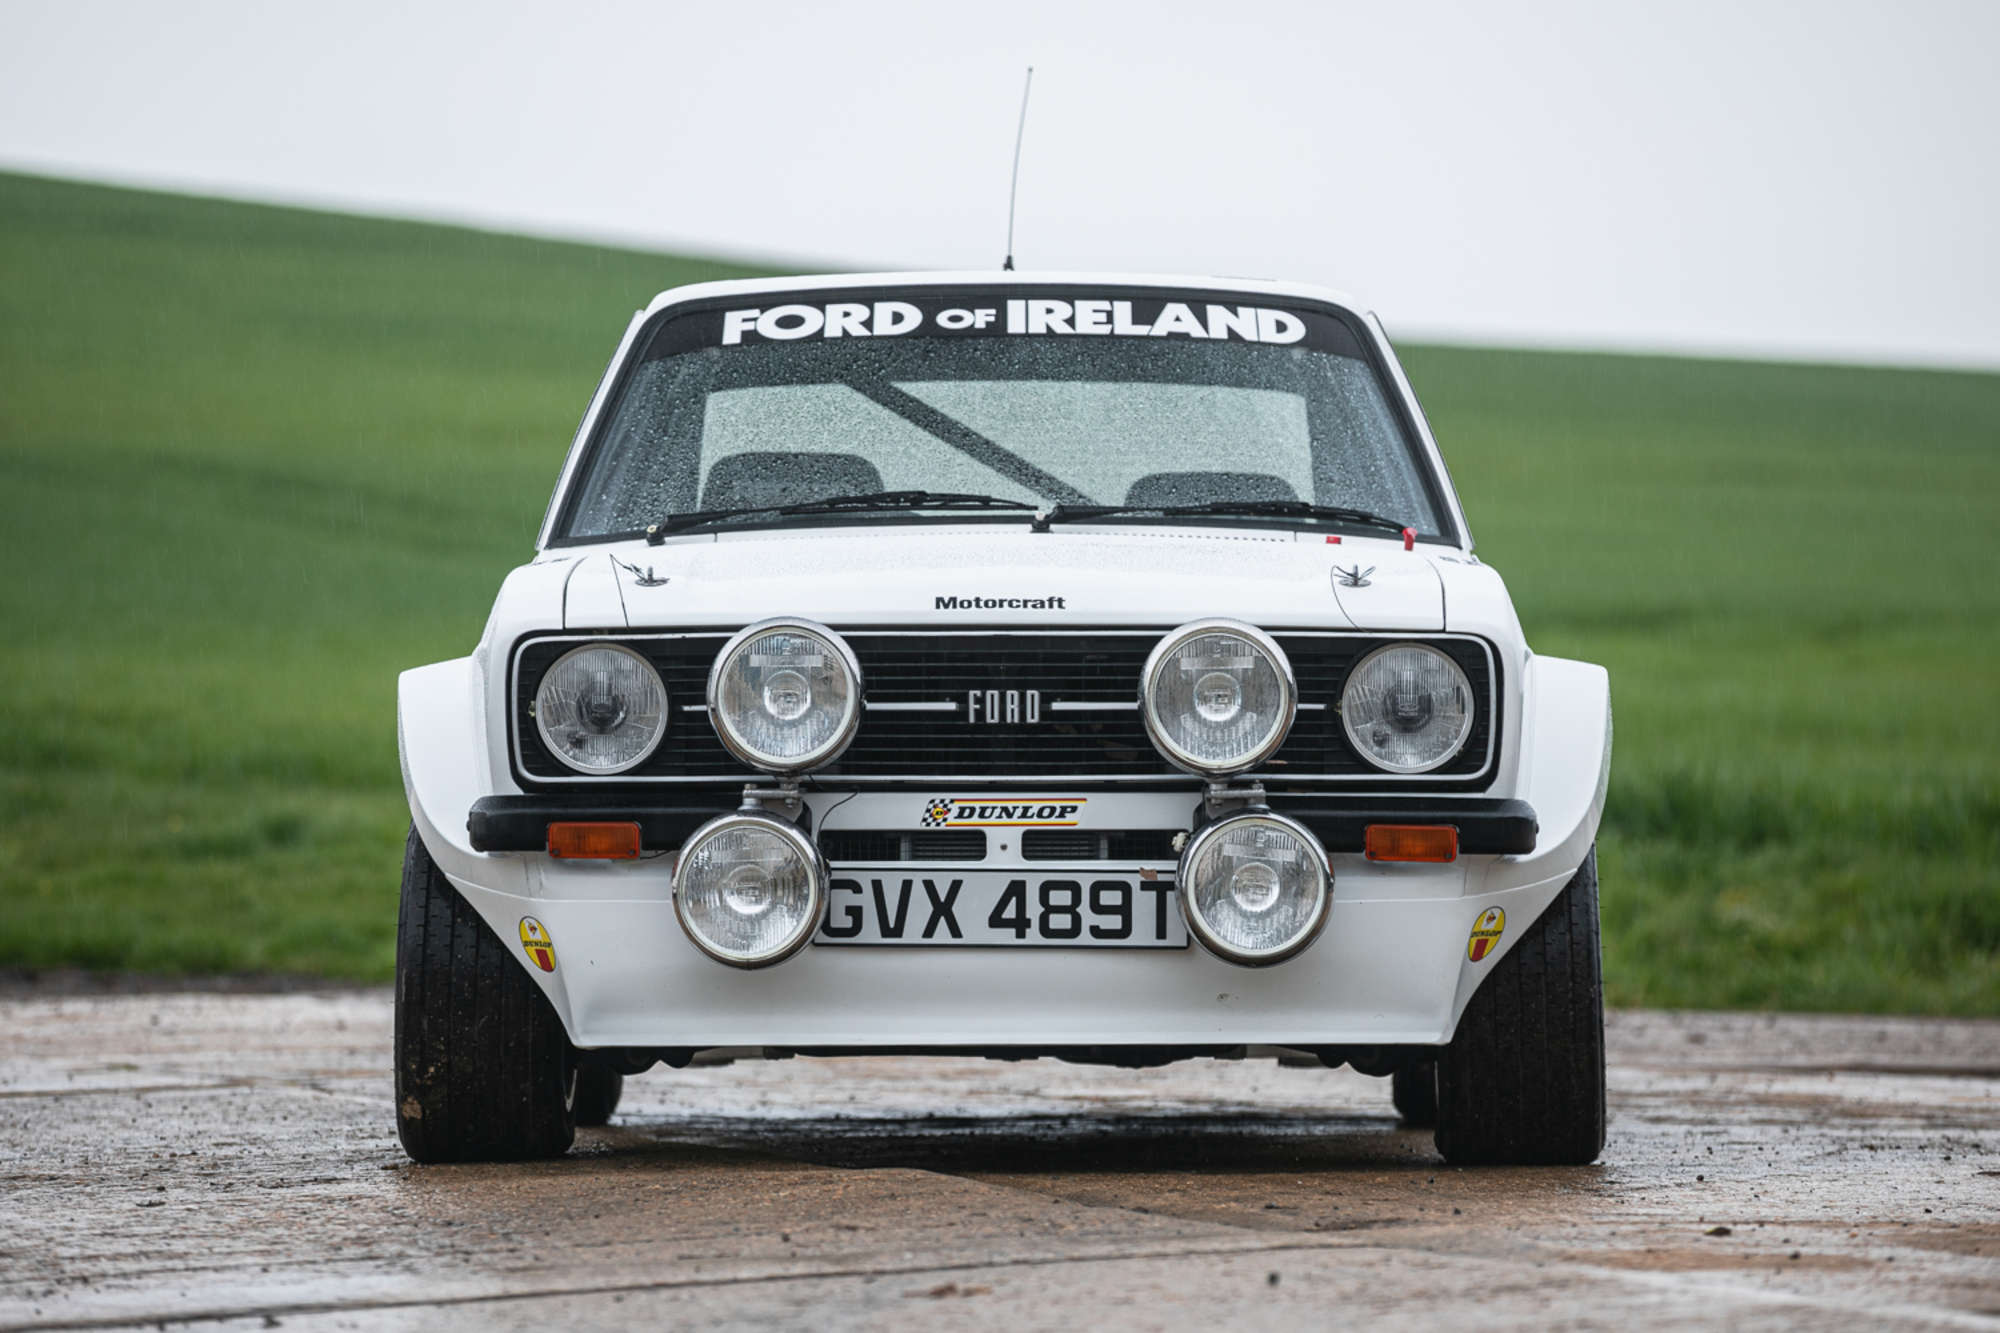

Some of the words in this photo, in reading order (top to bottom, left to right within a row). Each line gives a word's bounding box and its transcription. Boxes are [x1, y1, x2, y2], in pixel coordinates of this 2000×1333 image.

[722, 302, 923, 345] FORD
[935, 308, 997, 329] OF
[1006, 299, 1306, 343] IRELAND
[935, 596, 1066, 610] Motorcraft
[968, 690, 1040, 724] FORD
[953, 805, 1079, 819] DUNLOP
[821, 879, 963, 939] GVX
[988, 880, 1175, 940] 489T
